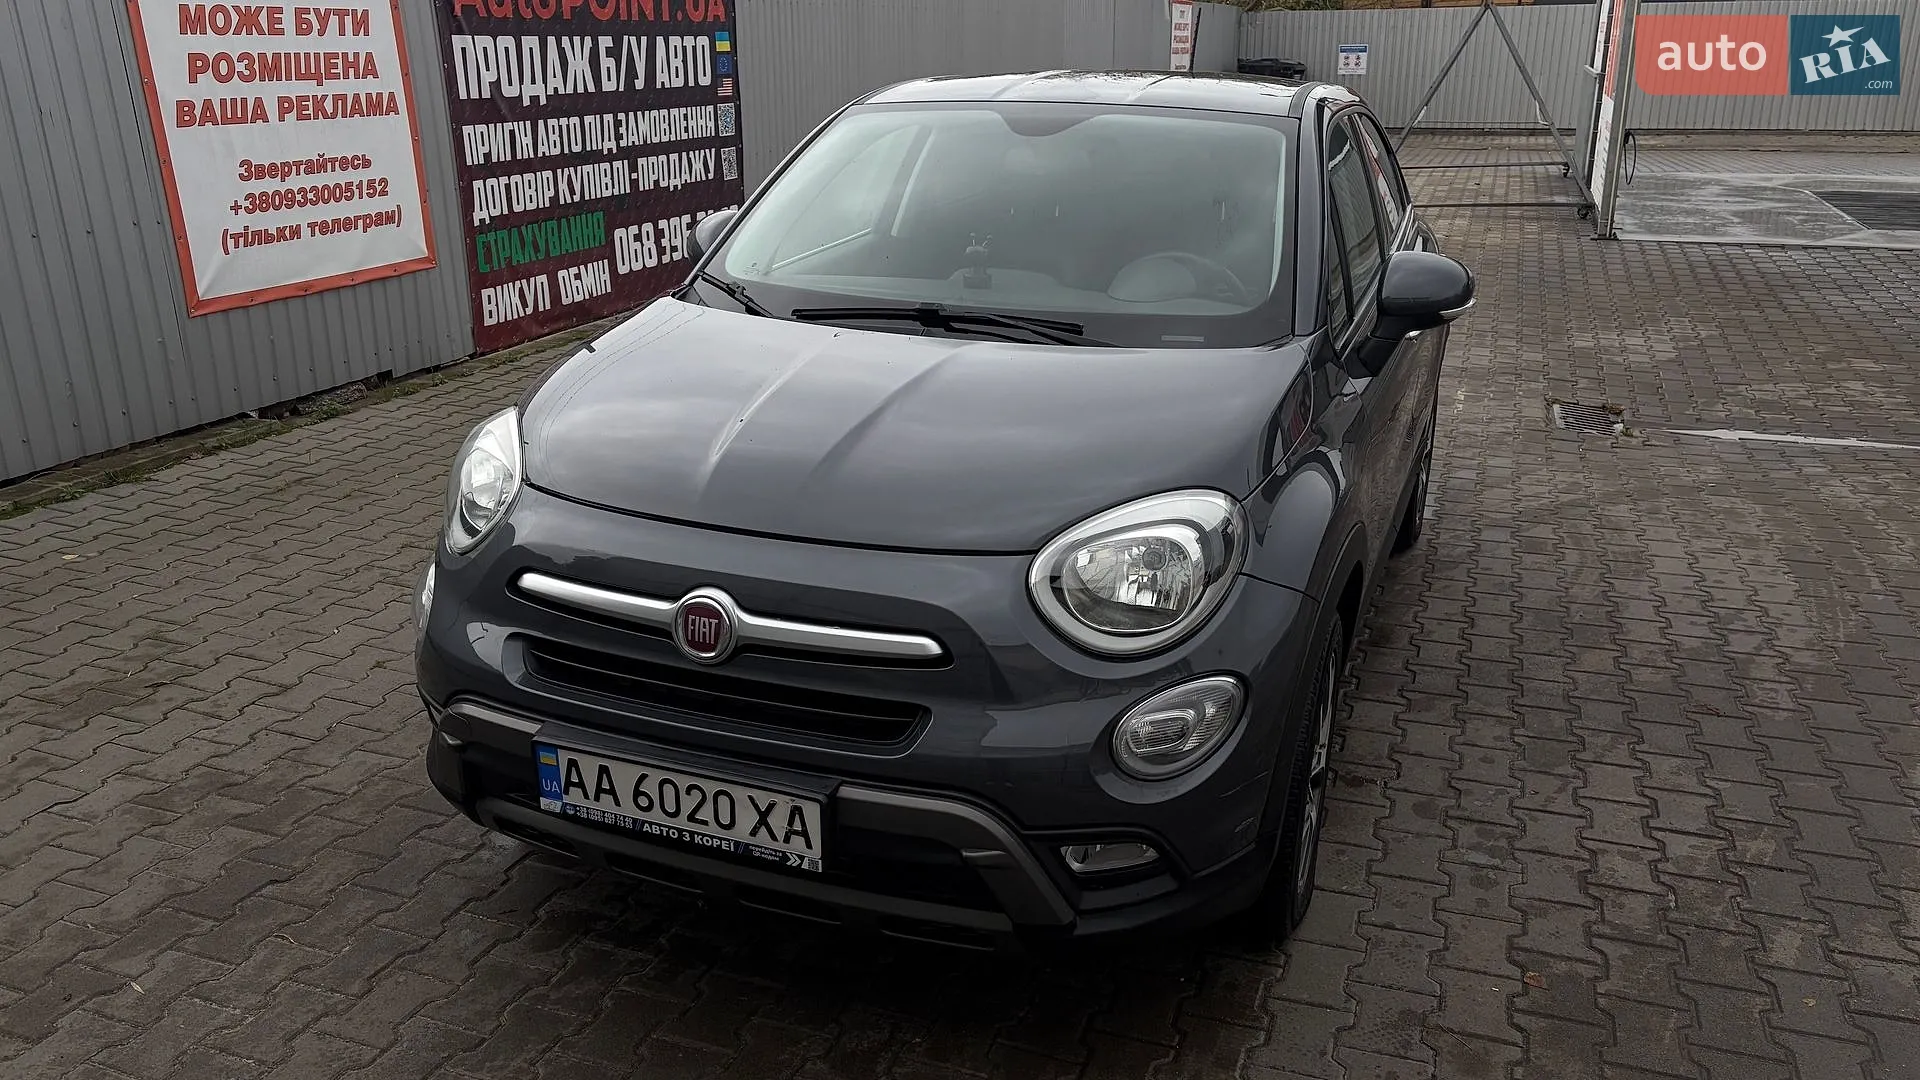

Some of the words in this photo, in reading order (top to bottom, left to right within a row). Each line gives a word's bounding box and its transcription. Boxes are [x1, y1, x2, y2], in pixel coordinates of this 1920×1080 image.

[179, 4, 284, 36] МОЖЕ
[294, 7, 370, 36] БУТИ
[188, 52, 379, 86] РОЗМІЩЕНА
[451, 34, 596, 107] ПРОДАЖ
[599, 36, 647, 92] Б/У
[655, 35, 711, 89] АВТО
[176, 97, 269, 128] ВАША
[277, 92, 399, 121] РЕКЛАМА
[462, 121, 535, 165] ПРИГІН
[537, 116, 582, 158] АВТО
[583, 113, 617, 155] ПІД
[617, 105, 715, 145] ЗАМОВЛЕННЯ
[238, 153, 372, 182] Звертайтесь
[230, 178, 389, 216] +380933005152
[472, 170, 555, 227] ДОГОВІР
[221, 221, 301, 255] (тільки
[308, 205, 402, 238] телеграм)
[476, 211, 605, 273] СТРАХУВАННЯ
[614, 222, 658, 275] 068
[481, 274, 551, 326] ВИКУП
[557, 259, 612, 305] ОБМІН
[689, 615, 718, 644] FIAT
[542, 778, 560, 794] UA
[563, 757, 622, 808] AA
[632, 772, 736, 831] 6020
[747, 794, 814, 850] XA
[643, 823, 678, 839] АВТО
[682, 831, 690, 841] З
[694, 834, 735, 852] КОРЕЇ
